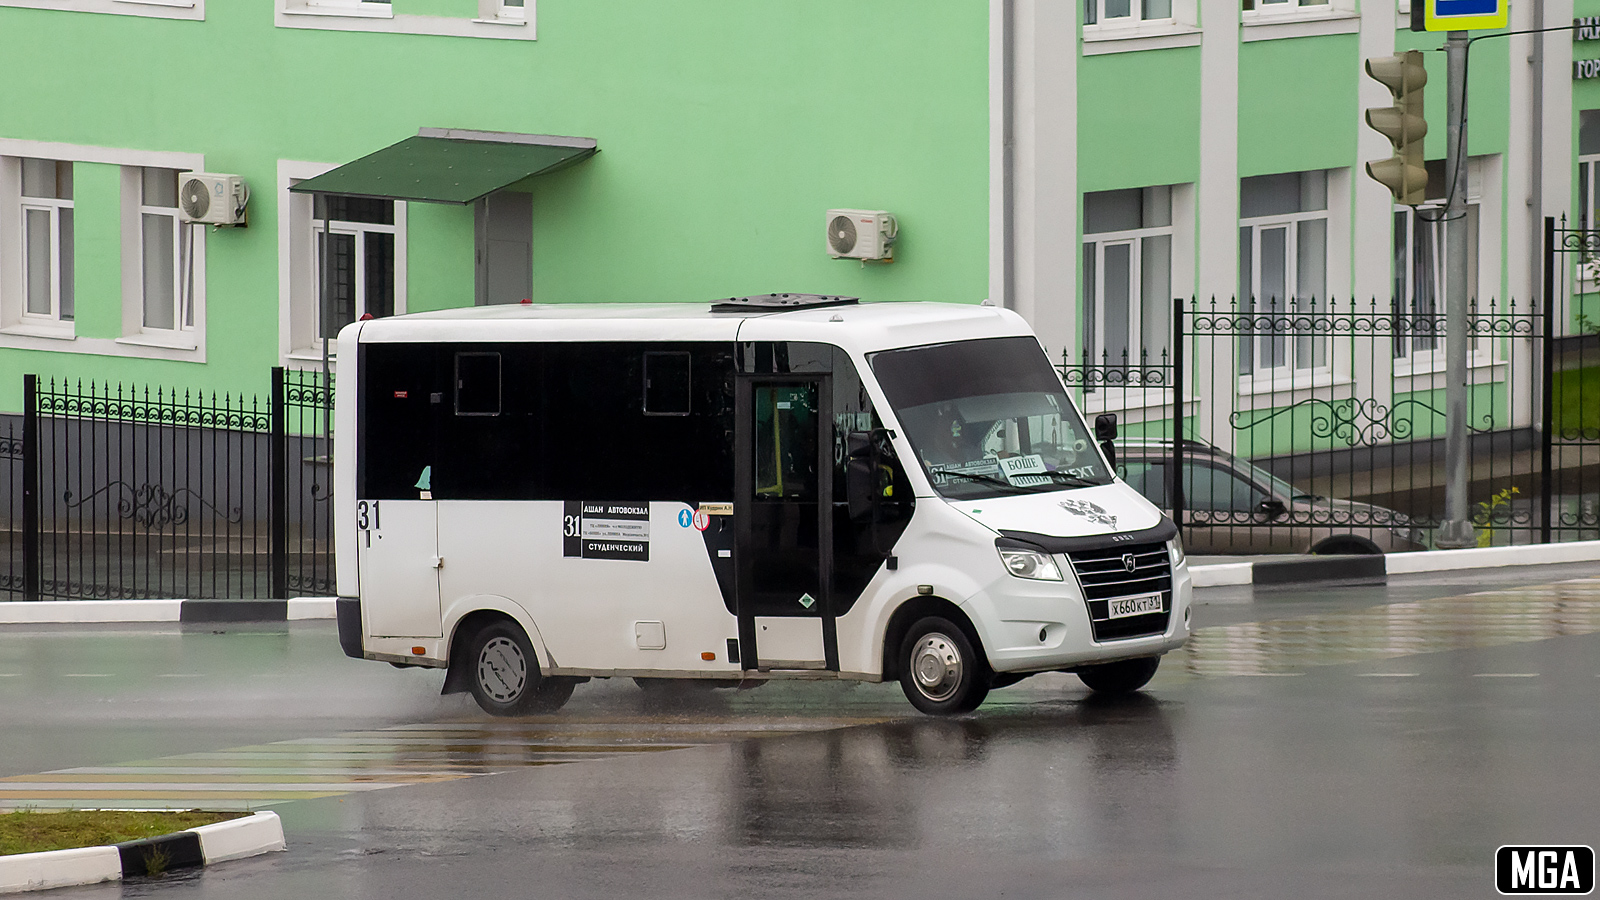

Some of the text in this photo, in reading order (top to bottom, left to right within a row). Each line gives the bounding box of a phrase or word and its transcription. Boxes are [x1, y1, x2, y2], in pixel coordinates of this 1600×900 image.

[1007, 458, 1039, 471] БОШЕ
[358, 500, 381, 530] 31
[583, 505, 649, 515] АШАН АВТОВОКЗАЛ
[563, 514, 582, 538] 31
[588, 543, 644, 553] СТУДЕНЧЕСКИЙ
